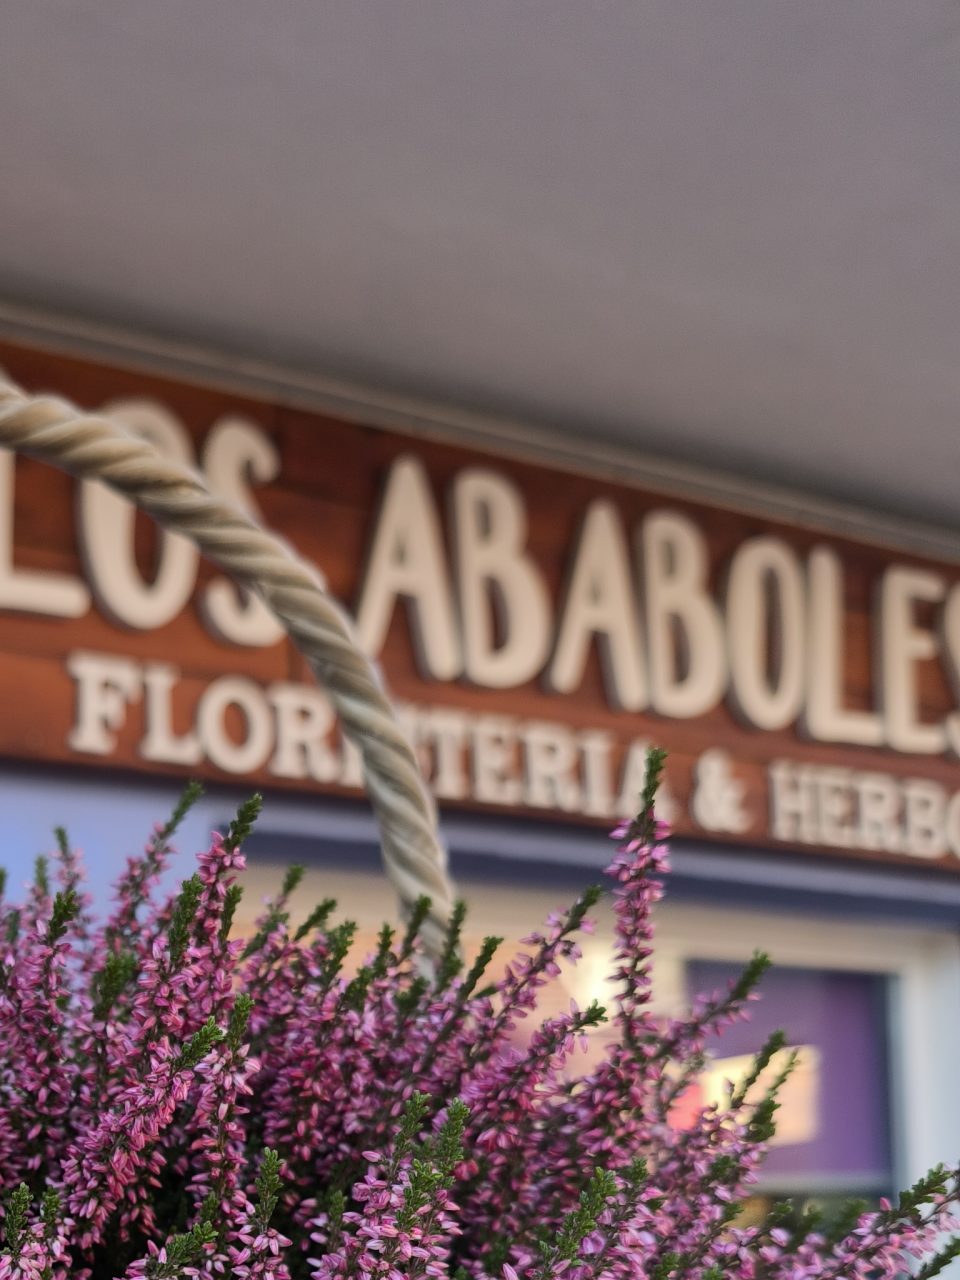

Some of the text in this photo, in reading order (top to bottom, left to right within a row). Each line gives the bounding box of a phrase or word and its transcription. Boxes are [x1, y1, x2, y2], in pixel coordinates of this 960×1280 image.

[354, 453, 960, 757] ABABOLE
[692, 746, 754, 834] &
[769, 760, 960, 860] HERB
